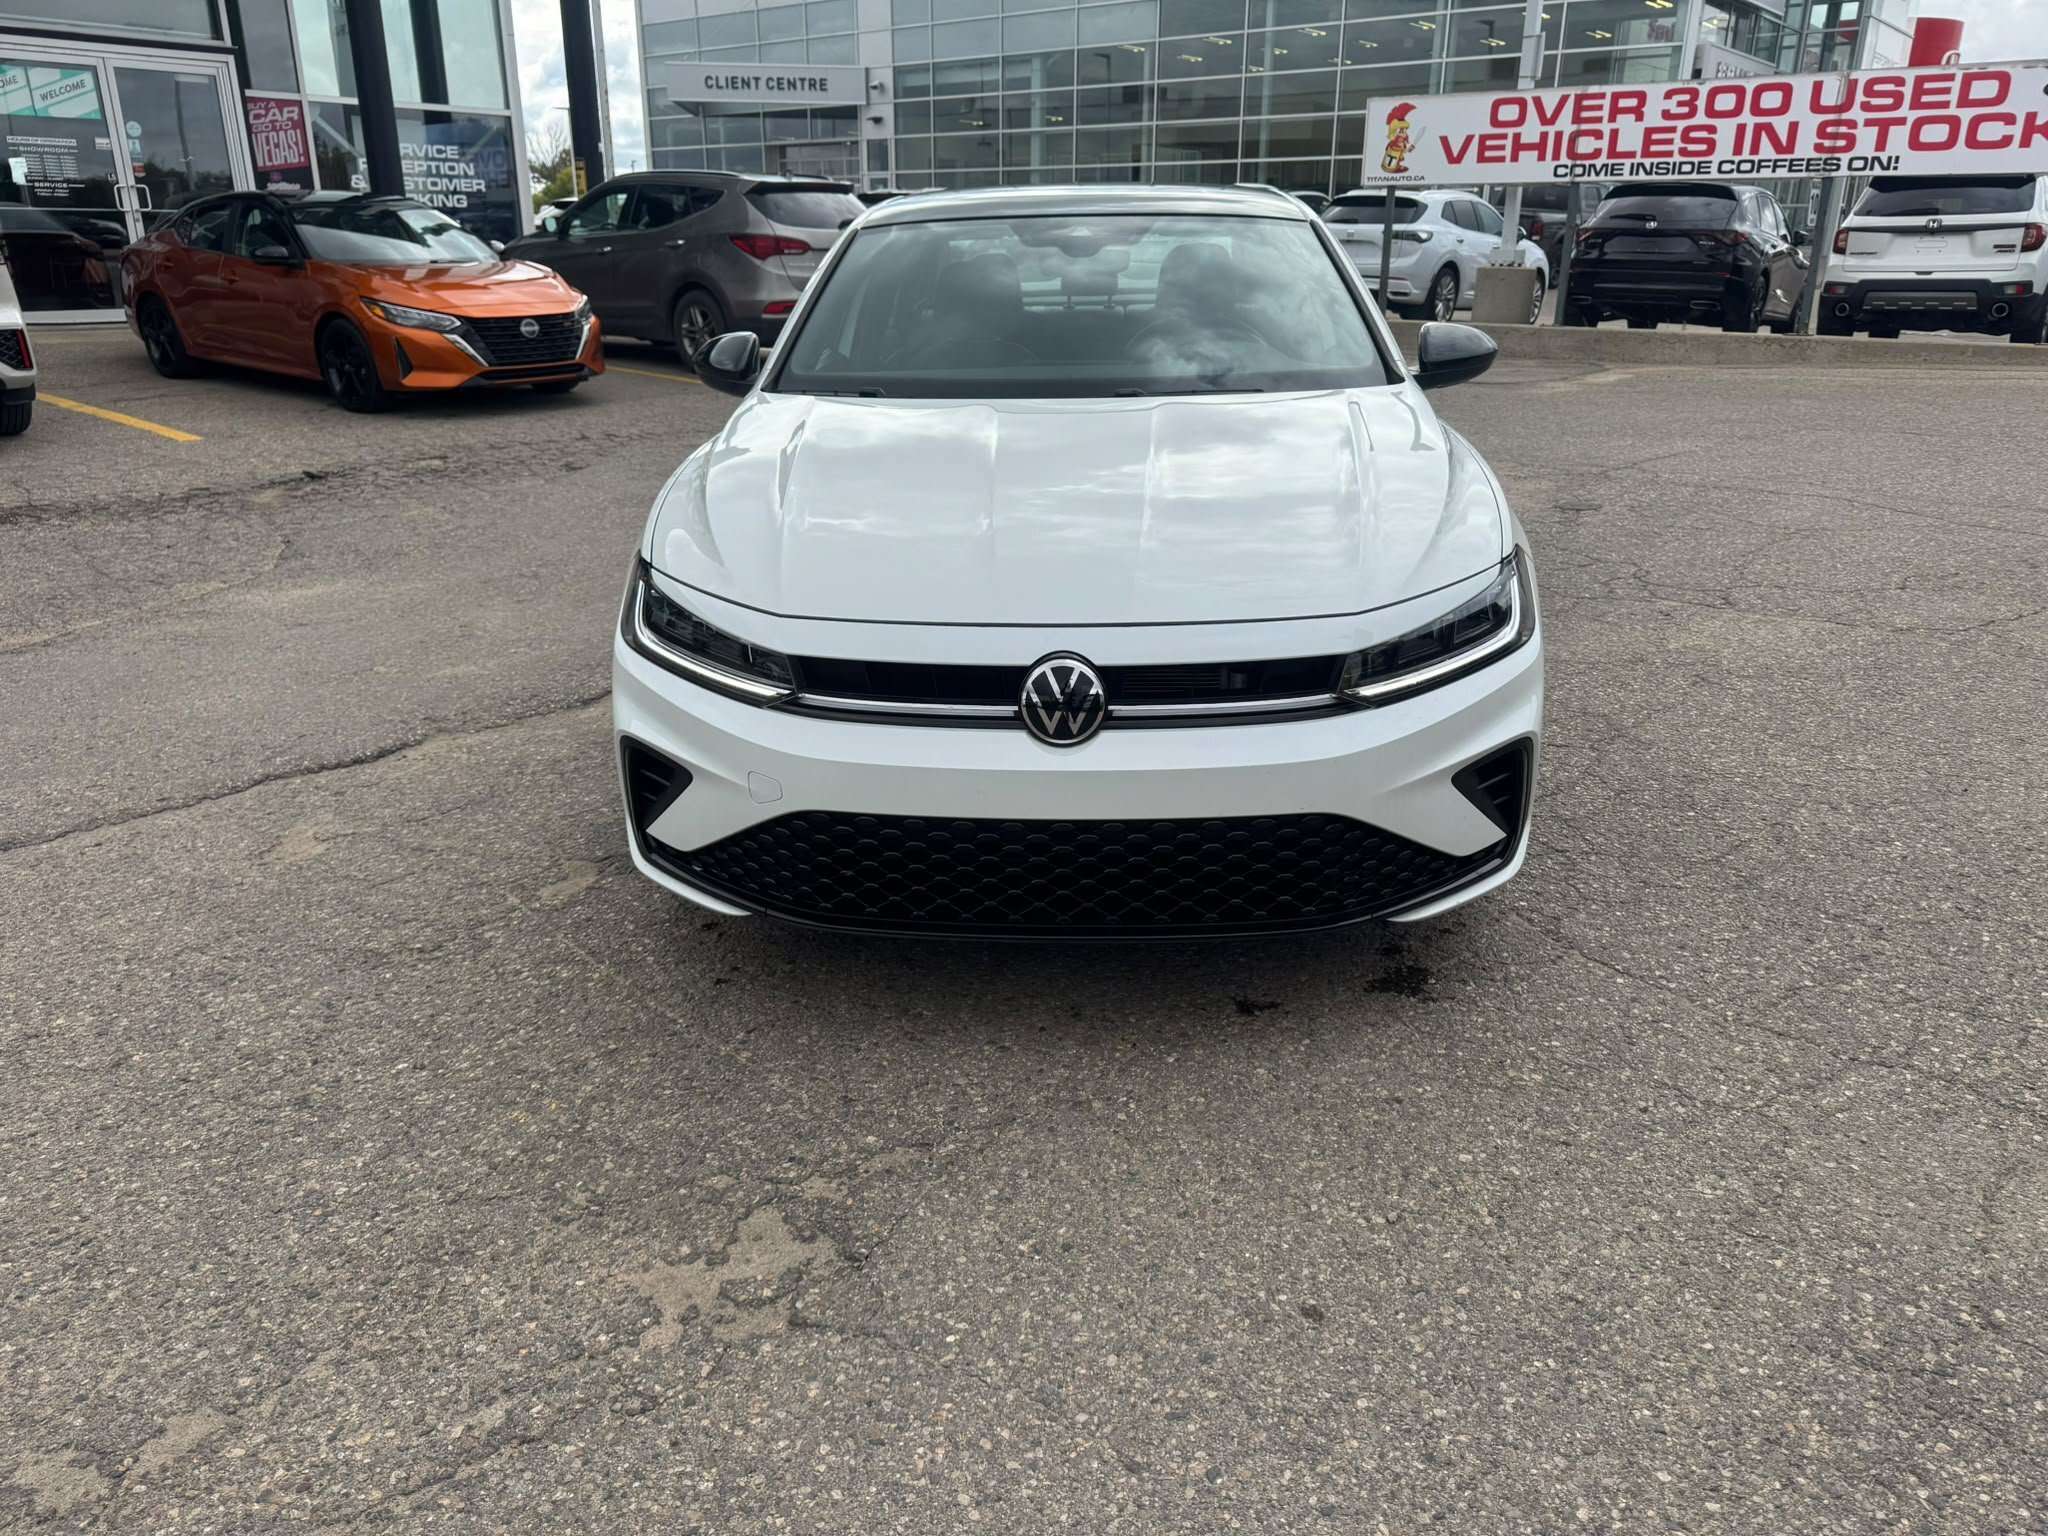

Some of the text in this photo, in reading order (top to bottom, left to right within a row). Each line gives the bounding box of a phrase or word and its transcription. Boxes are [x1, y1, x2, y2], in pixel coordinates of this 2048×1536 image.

[39, 79, 87, 102] WELCOME
[704, 75, 828, 92] CLIENT CENTRE
[1489, 70, 2012, 128] OVER 300 USED
[249, 106, 299, 124] CAR
[252, 121, 292, 132] GO TO
[1439, 111, 2048, 164] VEHICLES IN STOCK
[252, 129, 305, 168] VEGAS!
[399, 143, 460, 159] RVICE
[1553, 155, 1900, 178] COME INSIDE COFFEES ON!
[351, 174, 486, 192] & STOMER
[1367, 175, 1425, 183] TITANAUTO.CA
